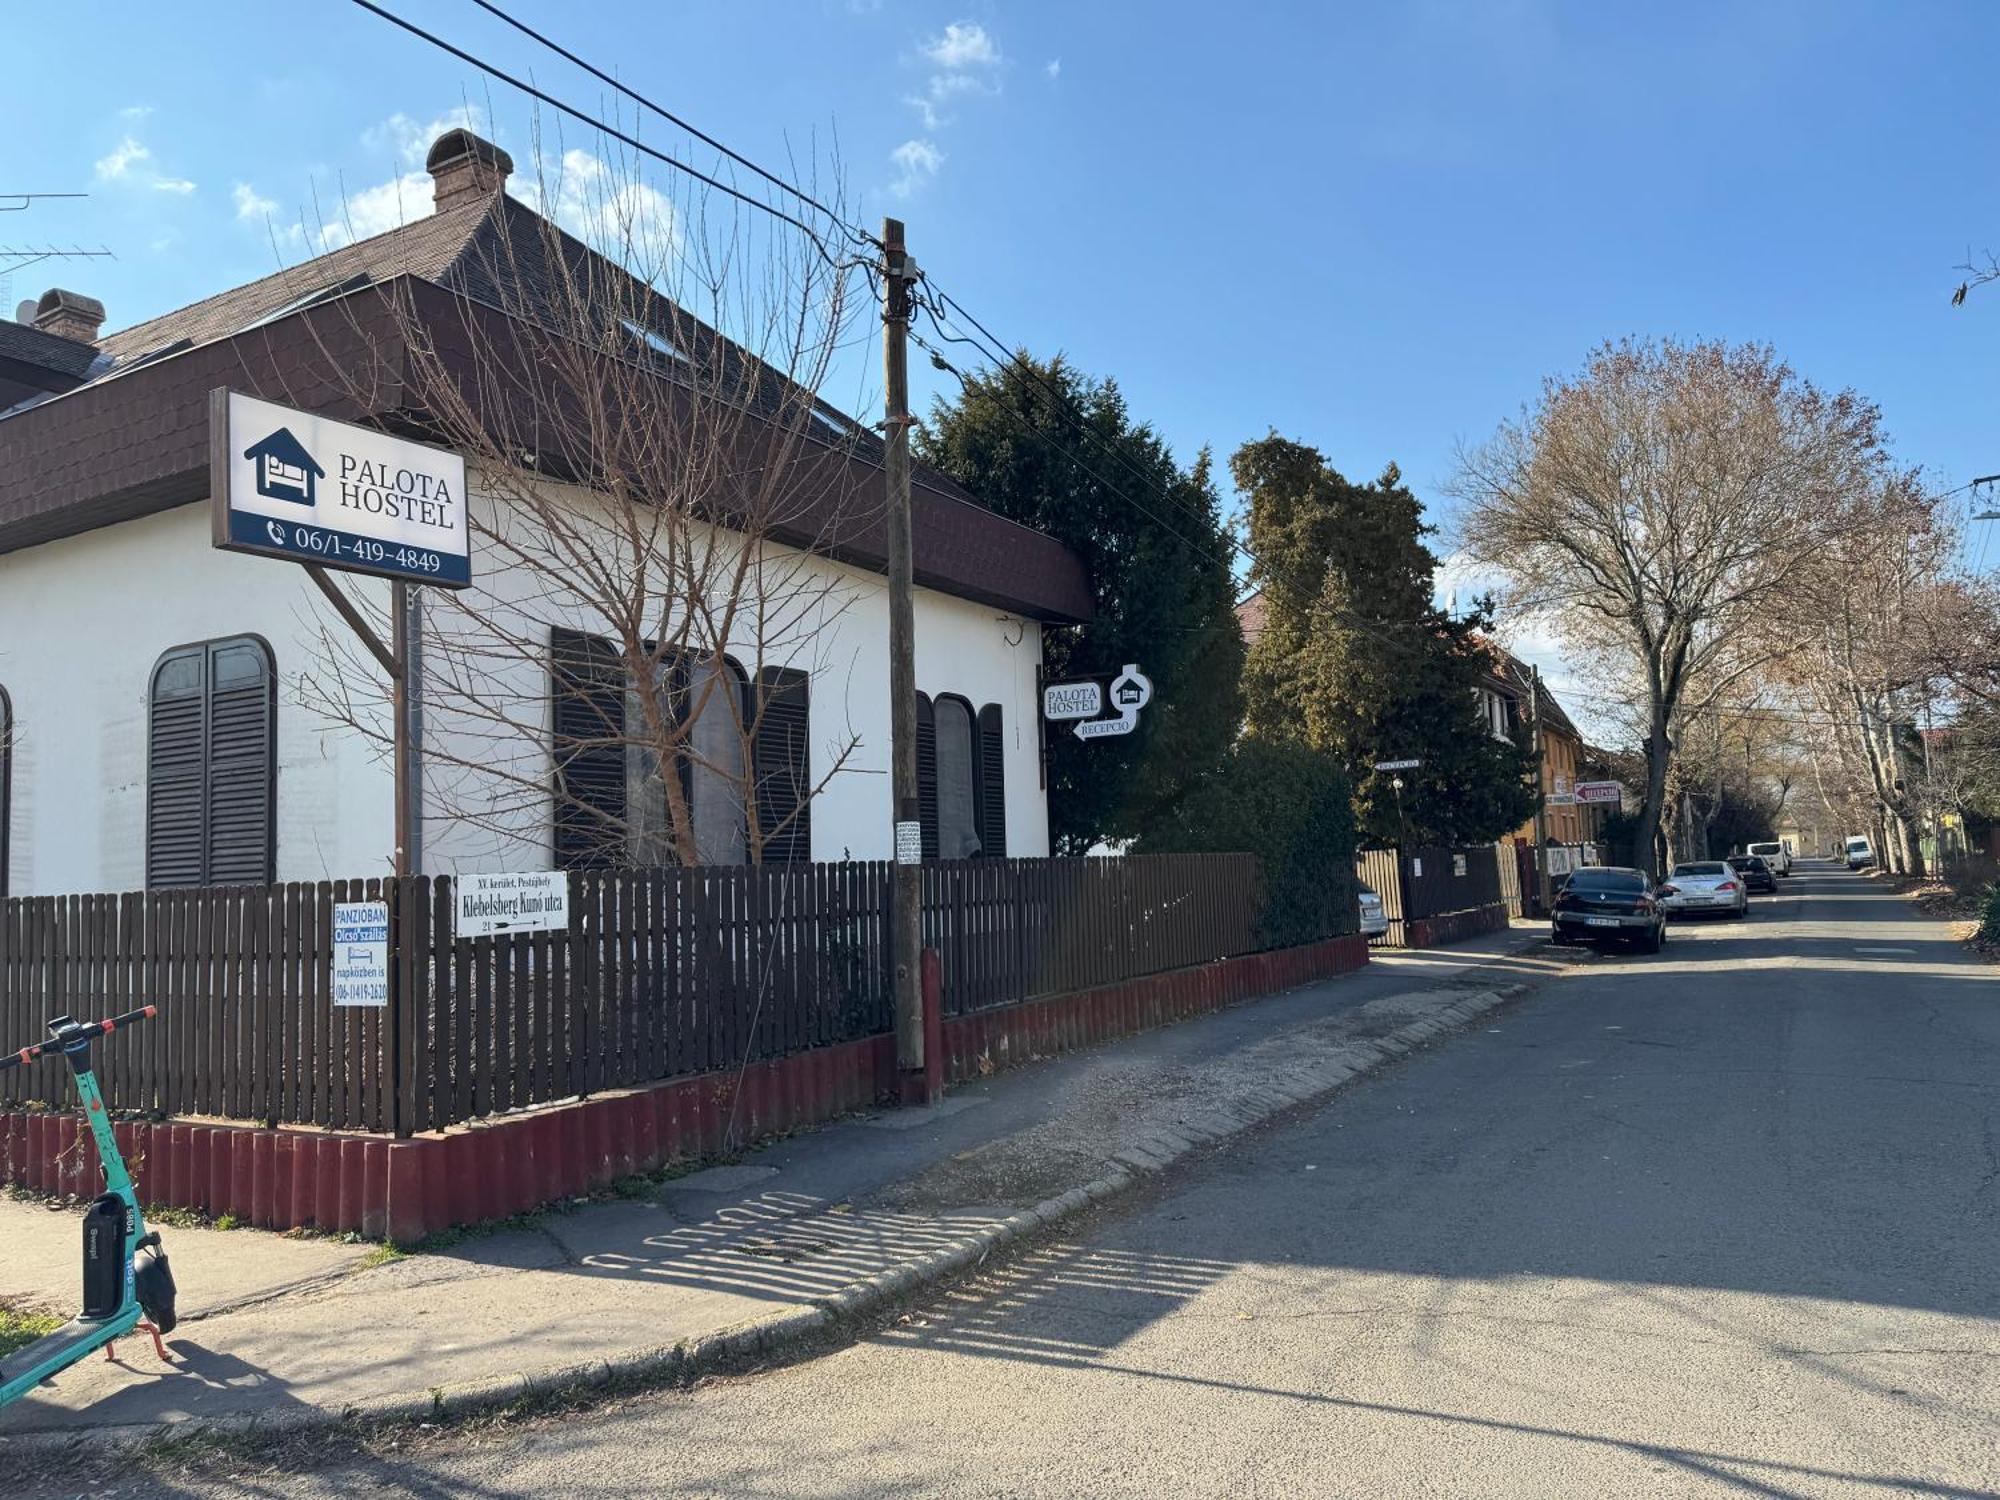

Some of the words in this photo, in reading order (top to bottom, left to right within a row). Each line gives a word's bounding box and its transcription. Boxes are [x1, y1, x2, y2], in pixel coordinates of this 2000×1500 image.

[339, 453, 454, 505] PALOTA
[339, 481, 454, 530] HOSTEL
[295, 527, 441, 573] 06/1-419-4849
[1048, 688, 1097, 703] PALOTA
[1048, 700, 1098, 714] HOSTEL
[335, 905, 386, 923] PANZIÓBAN
[463, 892, 519, 919] Klebelsberg
[520, 891, 544, 913] Kunó
[544, 892, 563, 912] utca
[336, 966, 377, 980] napközben
[378, 965, 385, 978] is
